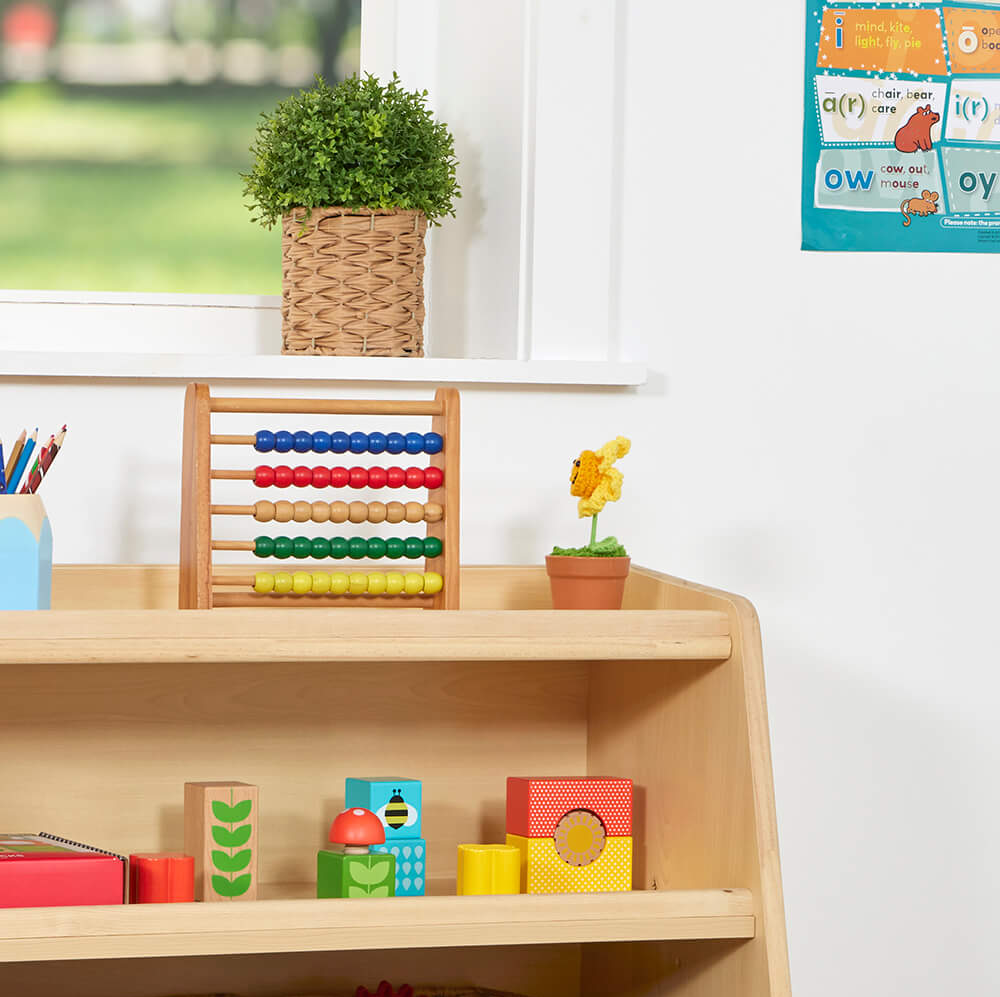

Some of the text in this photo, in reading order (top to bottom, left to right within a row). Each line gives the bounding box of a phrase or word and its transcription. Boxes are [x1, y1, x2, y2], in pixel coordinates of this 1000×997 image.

[855, 21, 887, 33] mind,
[872, 88, 935, 101] chair, bear,
[872, 104, 897, 114] care
[955, 94, 989, 121] i(r)
[881, 164, 930, 175] cow, out,
[825, 169, 874, 190] ow
[881, 179, 919, 188] mouse
[959, 172, 996, 200] oy
